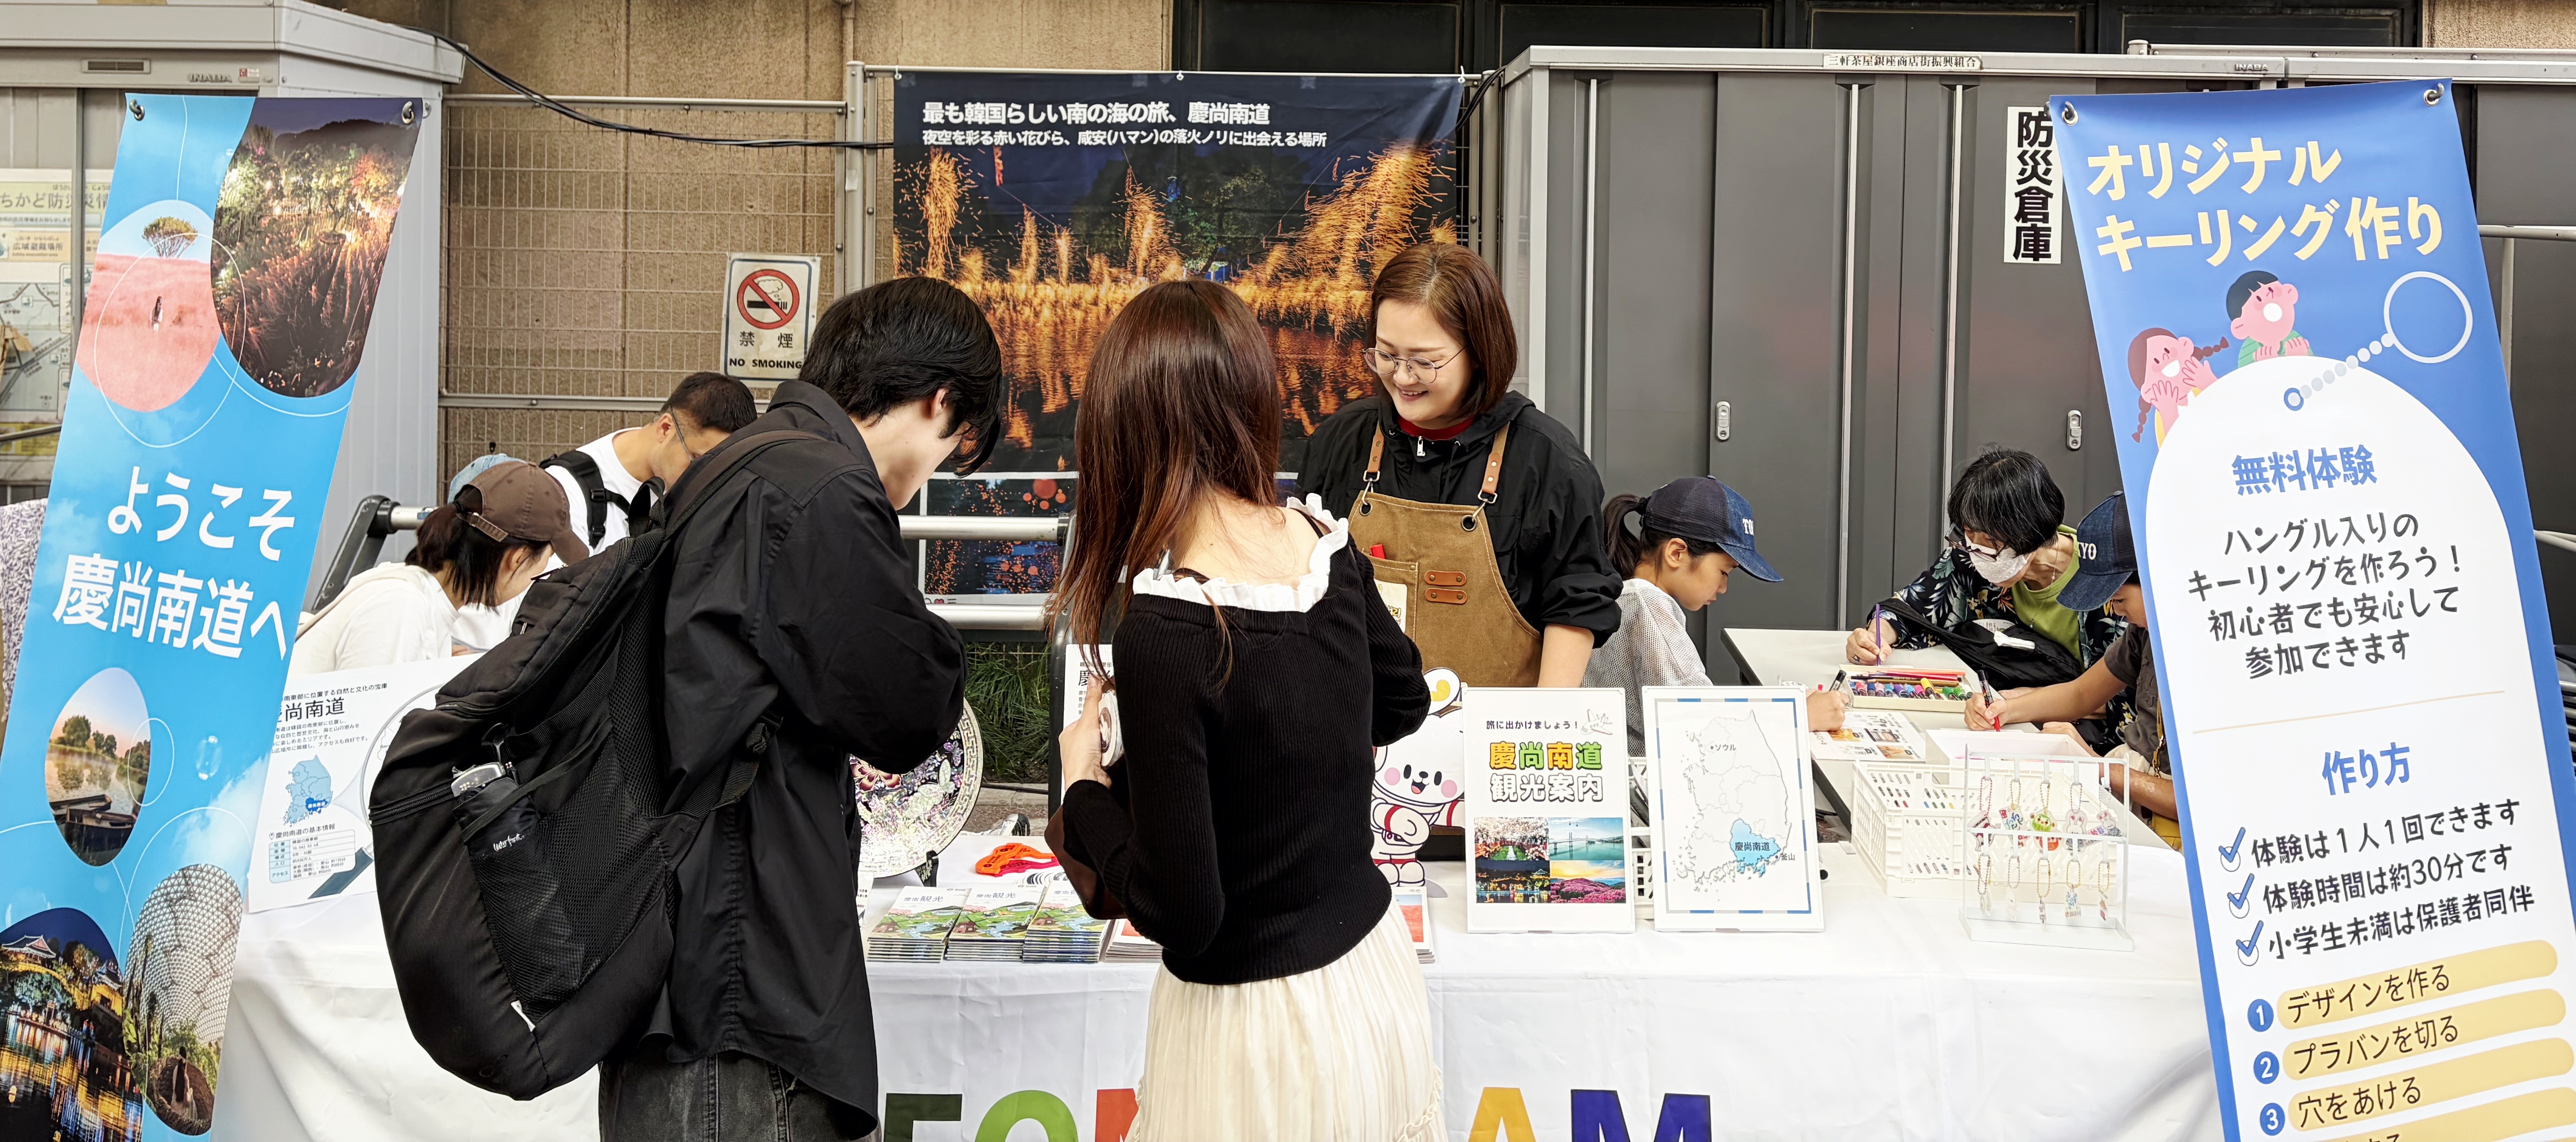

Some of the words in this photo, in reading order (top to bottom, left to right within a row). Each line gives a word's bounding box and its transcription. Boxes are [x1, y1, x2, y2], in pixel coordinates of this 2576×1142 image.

[1829, 56, 1976, 67] 三軒茶屋銀座商店街振興組合
[2235, 63, 2269, 72] INABA
[923, 102, 1270, 125] 最も韓国らしい南の海の旅、慶尚南道
[2013, 111, 2054, 262] 防災倉庫
[2087, 137, 2342, 201] オリジナル
[2096, 196, 2442, 272] キーリング作り
[729, 358, 745, 367] NO
[752, 359, 802, 369] SMOKING
[2232, 444, 2377, 496] 無料体験
[108, 466, 295, 561] ようこそ
[2224, 512, 2419, 555] ハングル入りの
[2188, 545, 2461, 602] キーリングを作ろう！
[52, 553, 286, 660] 慶尚南道へ
[2207, 587, 2459, 642] 初心者でも安心して
[2245, 629, 2410, 680] 参加できます
[277, 696, 345, 722] 尚南道
[1486, 720, 1578, 730] 旅に出かけましょう！
[1489, 741, 1603, 771] 慶尚南道
[1715, 743, 1737, 752] ソウル
[2322, 742, 2411, 795] 作り方
[1490, 773, 1604, 803] 観光案内
[1735, 841, 1770, 853] 慶尚南道
[1781, 852, 1796, 862] 釜山
[2263, 843, 2513, 914] 体験時間は約30分です
[2268, 884, 2535, 960] 小学生未満は保護者同伴
[2287, 964, 2450, 1024] デザインを作る
[2293, 1015, 2459, 1075] プラバンを切る
[2298, 1076, 2422, 1128] 穴をあける
